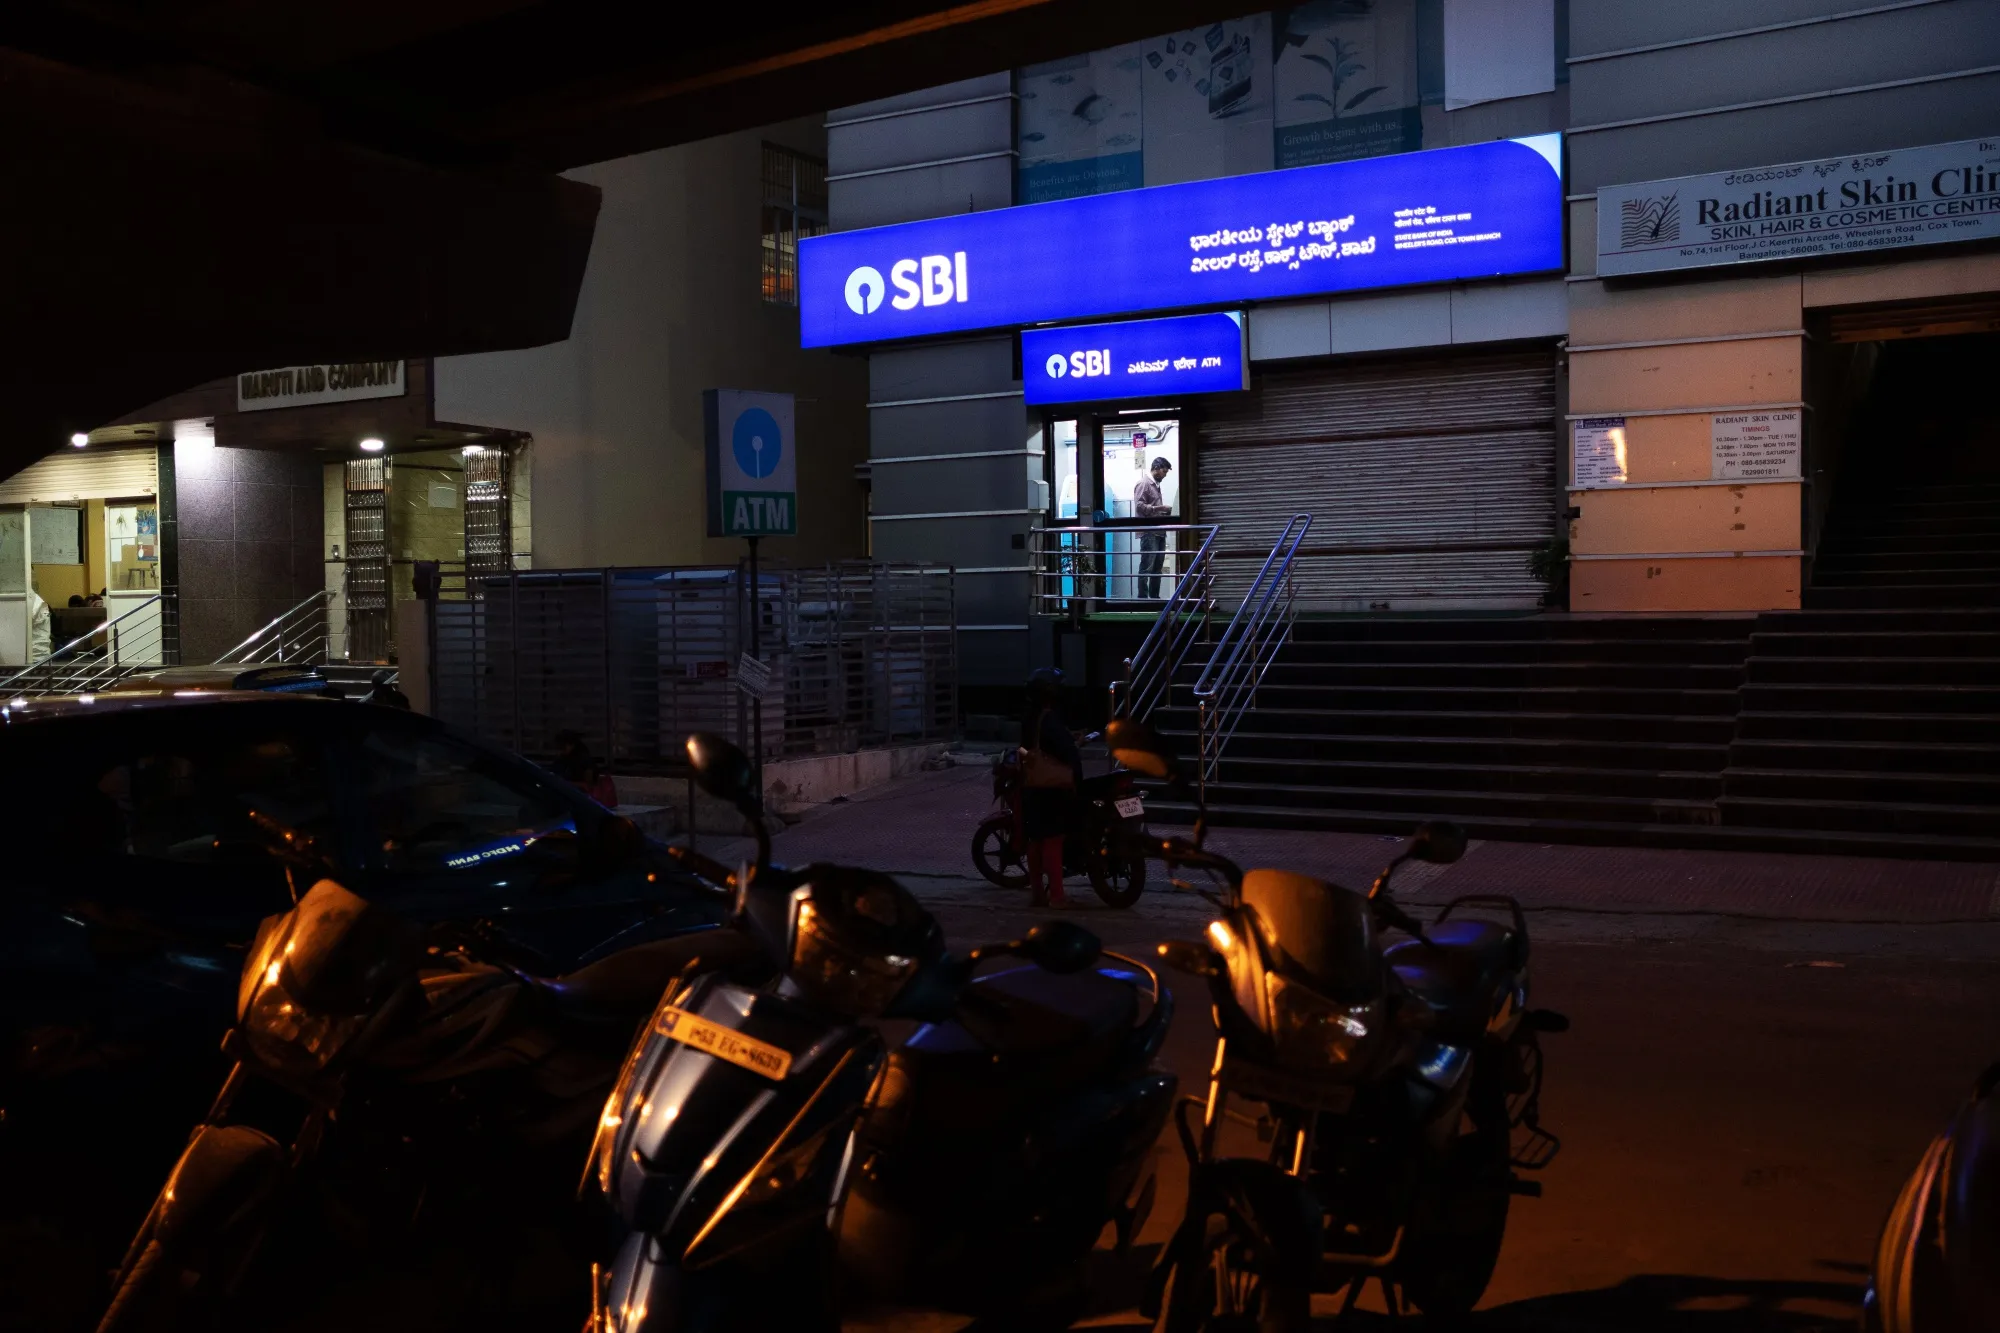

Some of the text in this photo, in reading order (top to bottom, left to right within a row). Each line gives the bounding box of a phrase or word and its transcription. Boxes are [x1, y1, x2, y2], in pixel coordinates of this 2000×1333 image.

[1283, 132, 1320, 146] Growth
[1323, 127, 1356, 141] begins
[1696, 187, 1829, 226] Radiant
[1840, 176, 1918, 208] Skin
[1711, 196, 2000, 241] SKIN, HAIR & COSMETIC CENTR
[1845, 227, 1892, 239] Wheelers
[1927, 221, 1948, 230] Cox
[1189, 226, 1263, 252] ಭಾರತೀಯ
[1307, 214, 1355, 243] ಬ್ಯಾಂಕ್
[1394, 229, 1454, 241] STATE BANK OF INDIA
[1444, 236, 1458, 244] COX
[1457, 235, 1476, 243] TOWN
[1475, 232, 1501, 241] BRANCH
[1190, 252, 1237, 273] ವೀಲರ್
[891, 251, 968, 311] SBI
[1070, 349, 1111, 378] SBI
[1201, 357, 1221, 368] ATM
[241, 361, 398, 399] MARUTI AND COMPANY
[1716, 416, 1748, 424] RADIANT
[1772, 413, 1797, 421] CLINIC
[732, 496, 789, 531] ATM
